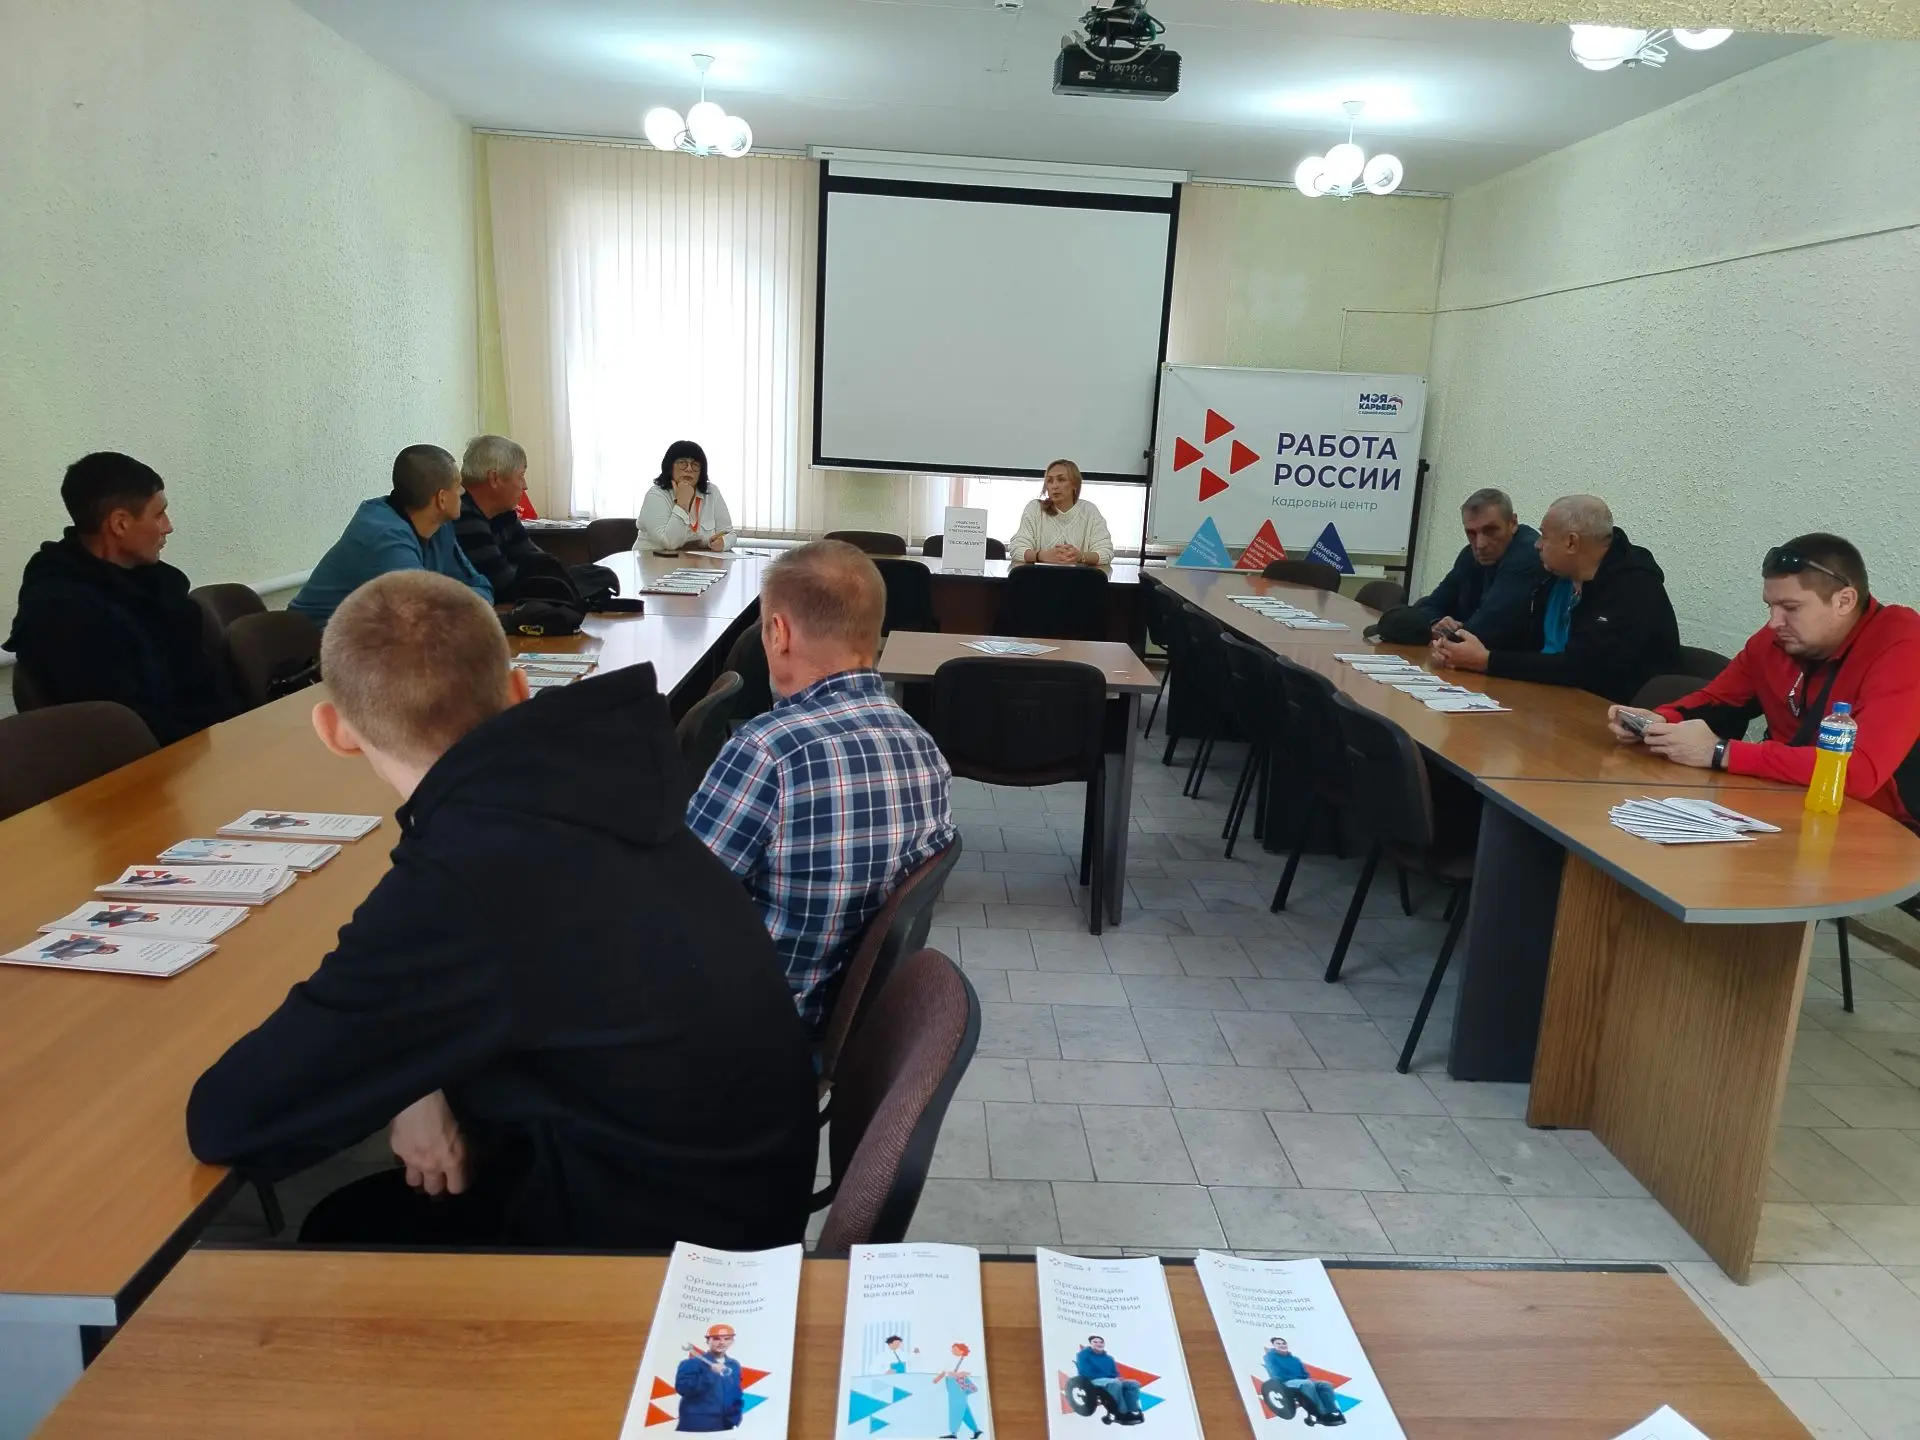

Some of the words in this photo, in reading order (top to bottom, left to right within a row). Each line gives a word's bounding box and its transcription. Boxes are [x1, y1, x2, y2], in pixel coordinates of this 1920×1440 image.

[1358, 402, 1398, 411] КАРЬЕРА
[1277, 432, 1398, 460] РАБОТА
[1274, 463, 1402, 491] РОССИИ
[1271, 495, 1338, 509] Кадровый
[1340, 500, 1379, 512] центр
[1312, 548, 1344, 571] сильнее!
[1316, 541, 1342, 562] Вместе
[1054, 1279, 1124, 1295] Организация
[1055, 1296, 1076, 1306] при
[1078, 1300, 1142, 1311] содействии
[678, 1311, 711, 1322] работ
[1057, 1313, 1117, 1329] инвалидов
